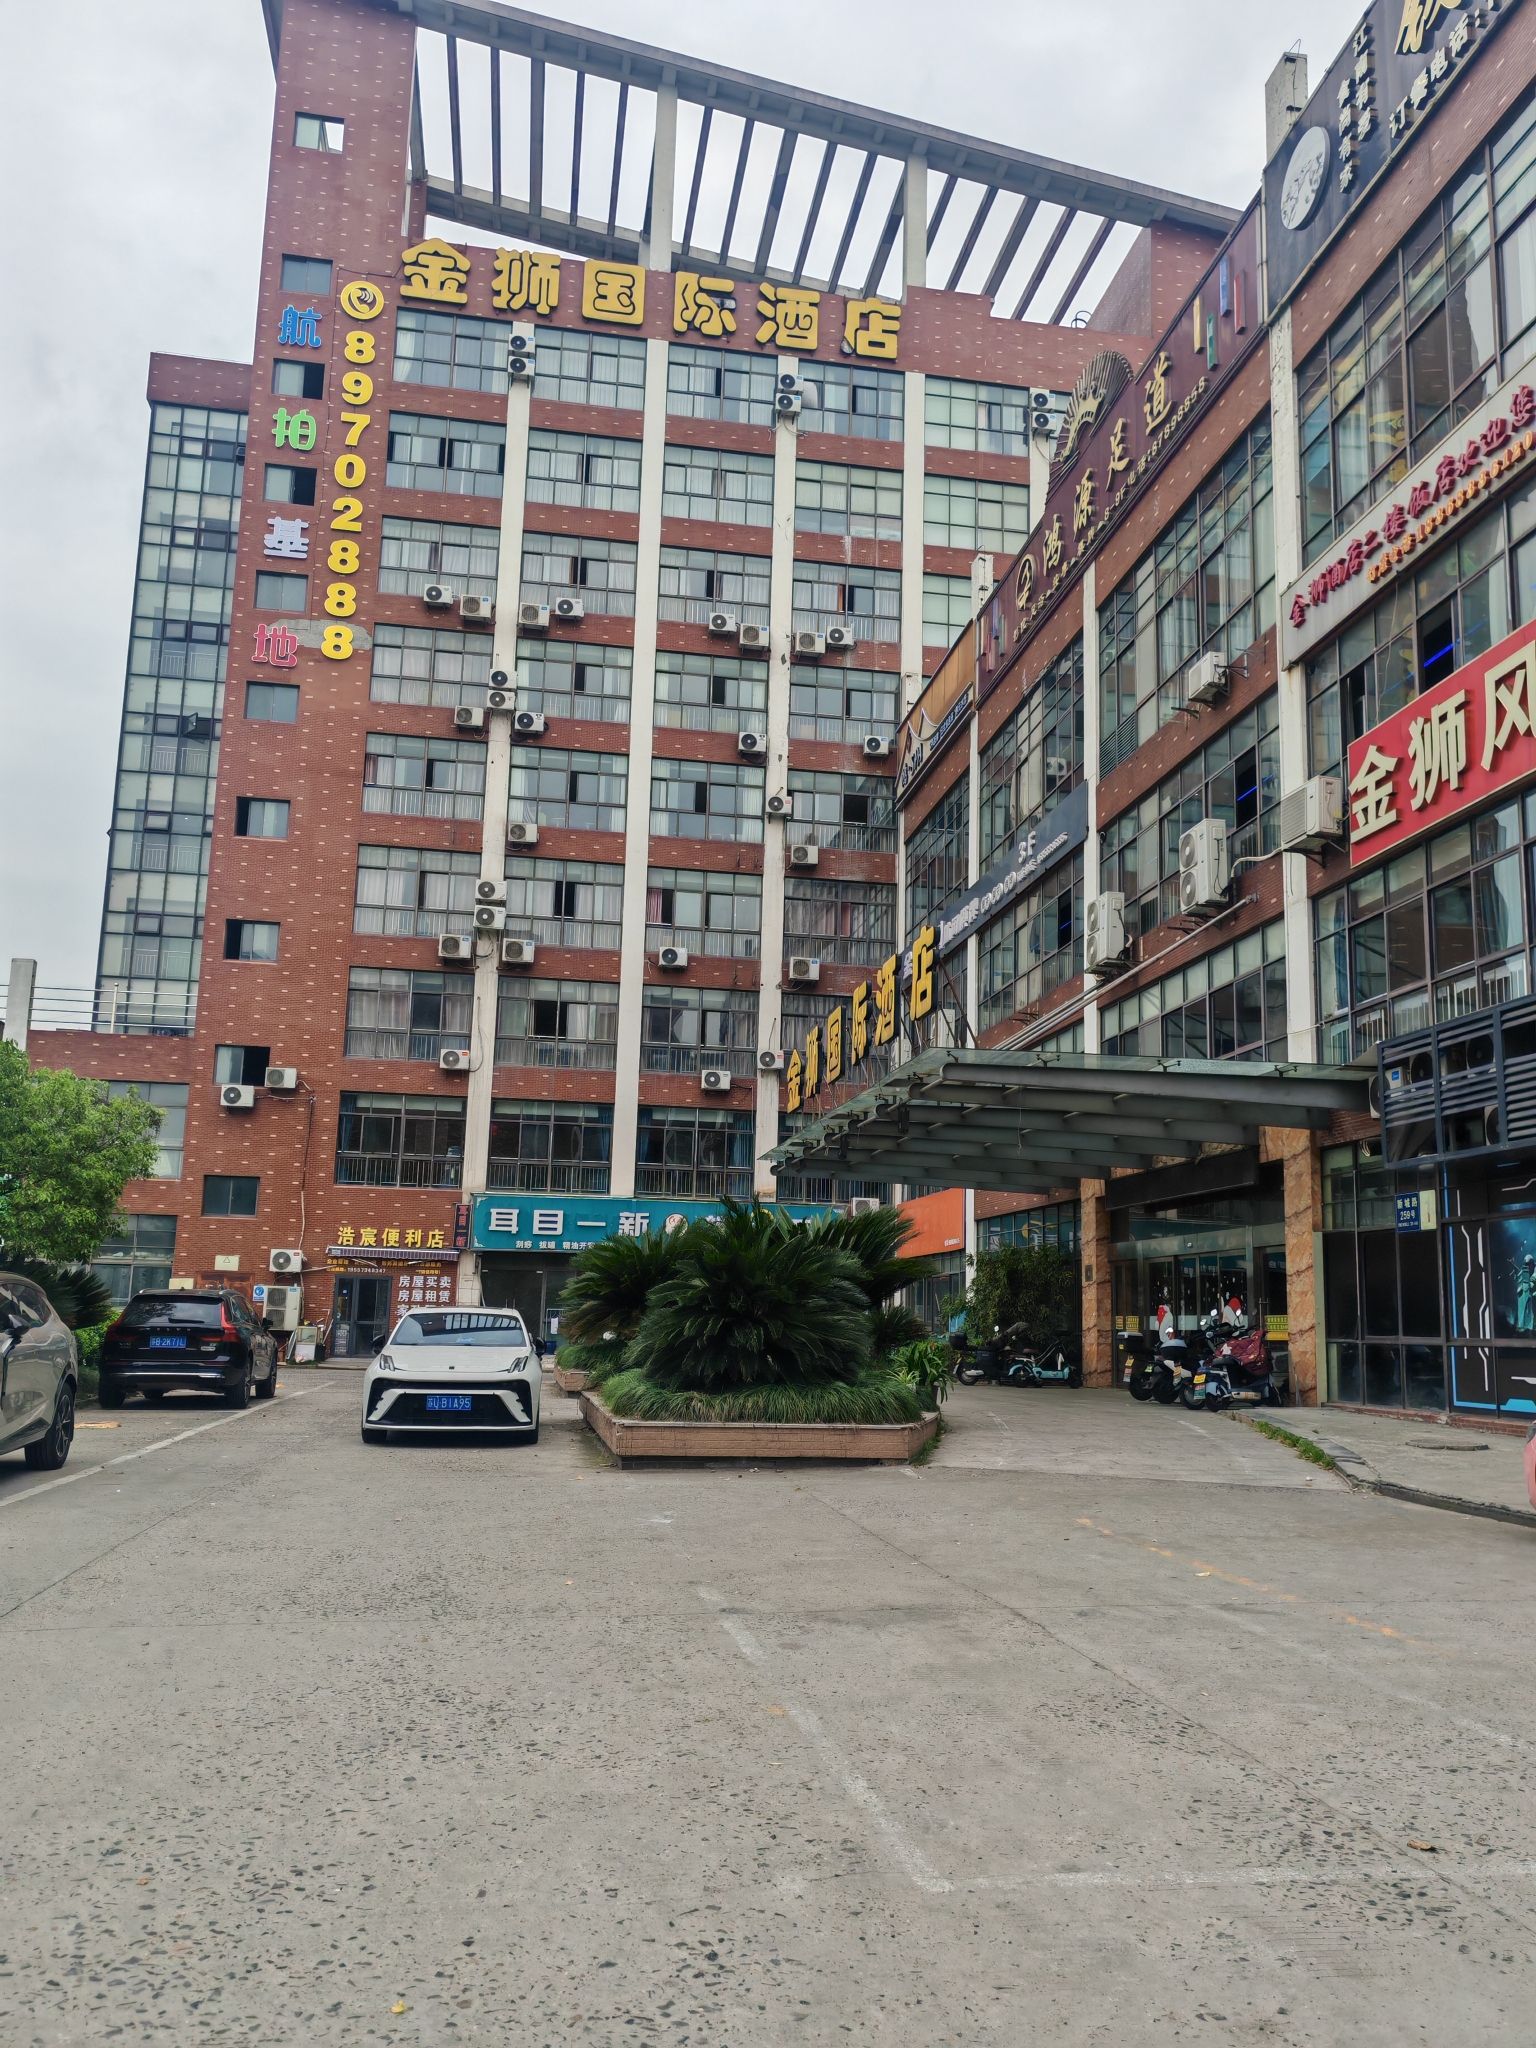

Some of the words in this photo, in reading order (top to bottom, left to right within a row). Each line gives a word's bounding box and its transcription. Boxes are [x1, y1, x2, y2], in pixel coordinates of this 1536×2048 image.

[400, 238, 902, 359] 金狮国际酒店
[252, 304, 324, 668] 航拍基地
[322, 330, 375, 660] 89702888
[1042, 351, 1173, 577] 鸿源足道
[1348, 640, 1536, 844] 金狮风
[1018, 831, 1037, 864] 3F
[787, 925, 935, 1113] 金狮国际酒店
[337, 1226, 446, 1249] 浩宸便利店
[488, 1208, 650, 1237] 耳目一新
[1397, 1196, 1418, 1209] 新城路
[397, 1289, 451, 1303] 房屋租赁
[398, 1275, 452, 1288] 房屋买卖
